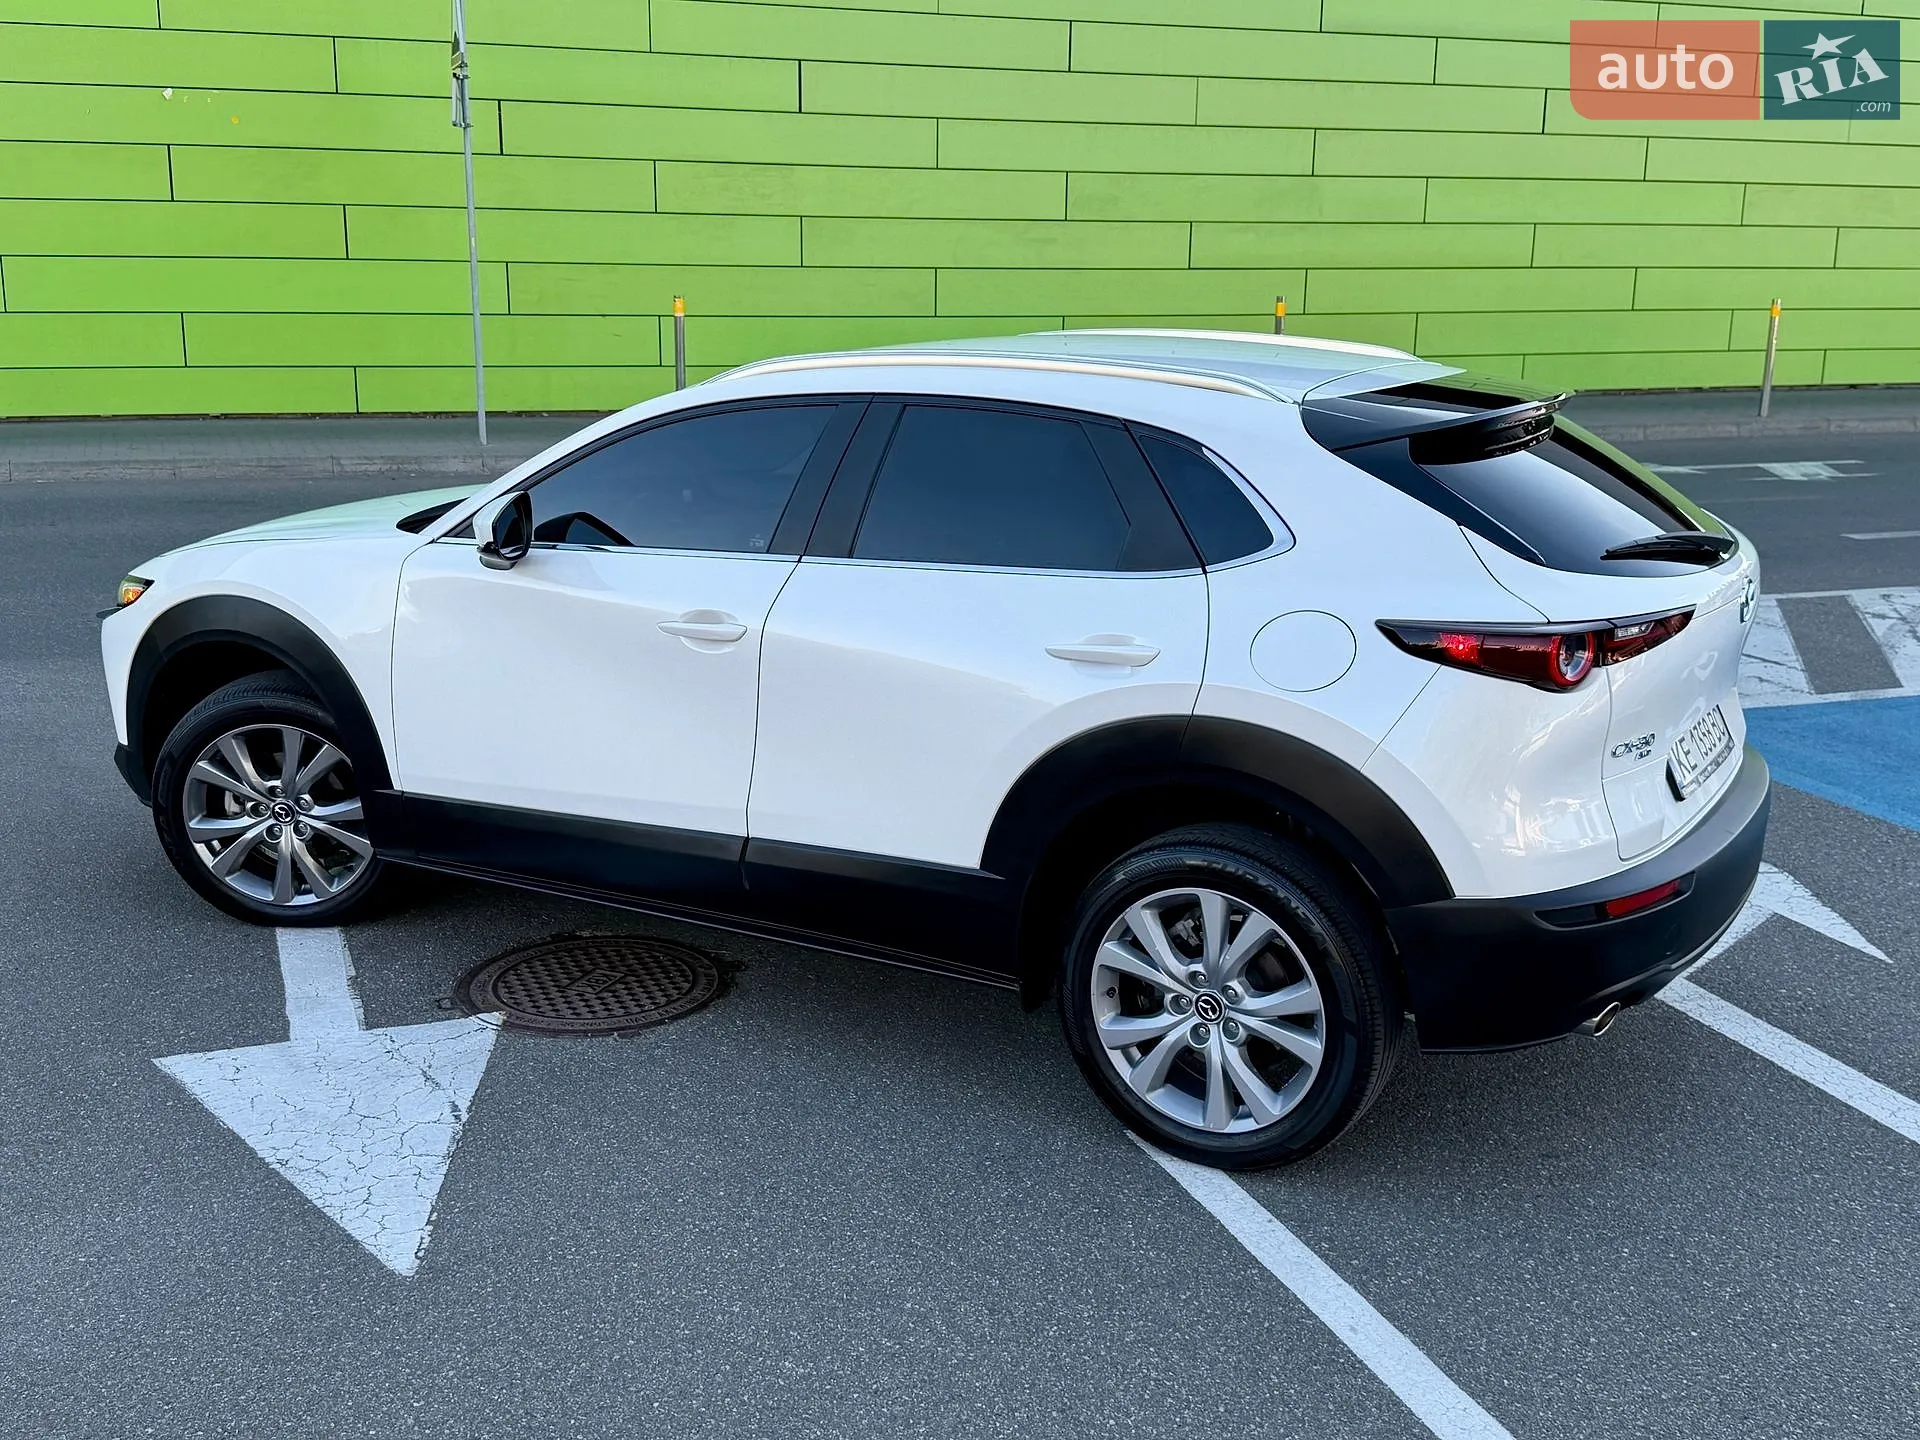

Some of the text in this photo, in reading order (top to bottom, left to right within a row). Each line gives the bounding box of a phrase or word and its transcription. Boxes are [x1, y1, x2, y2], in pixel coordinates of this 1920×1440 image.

[1670, 735, 1698, 780] KE
[1689, 716, 1717, 761] 1358
[1706, 706, 1727, 742] BC
